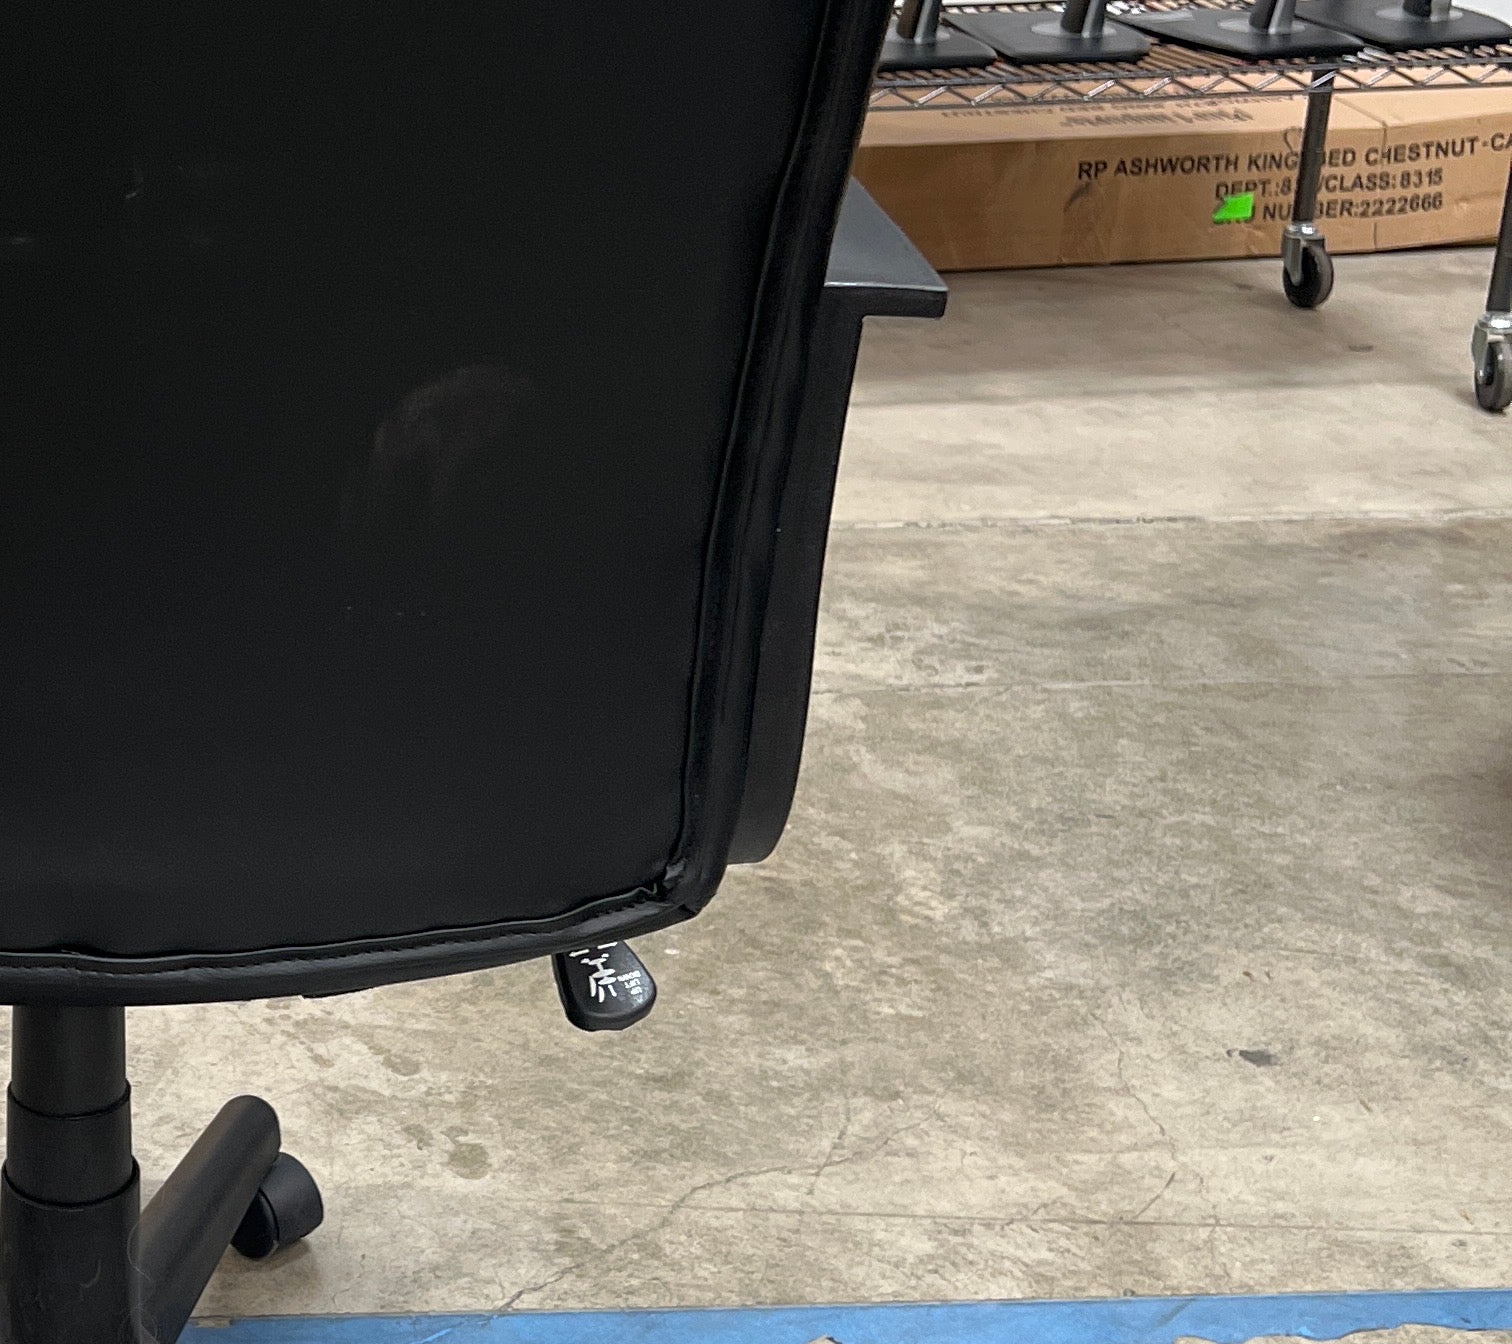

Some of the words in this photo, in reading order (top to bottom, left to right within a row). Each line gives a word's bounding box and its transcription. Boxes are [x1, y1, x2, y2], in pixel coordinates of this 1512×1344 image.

[1077, 159, 1108, 180] RP
[1113, 152, 1239, 177] ASHWORTH
[1247, 151, 1299, 172] KING
[1318, 147, 1356, 168] ED
